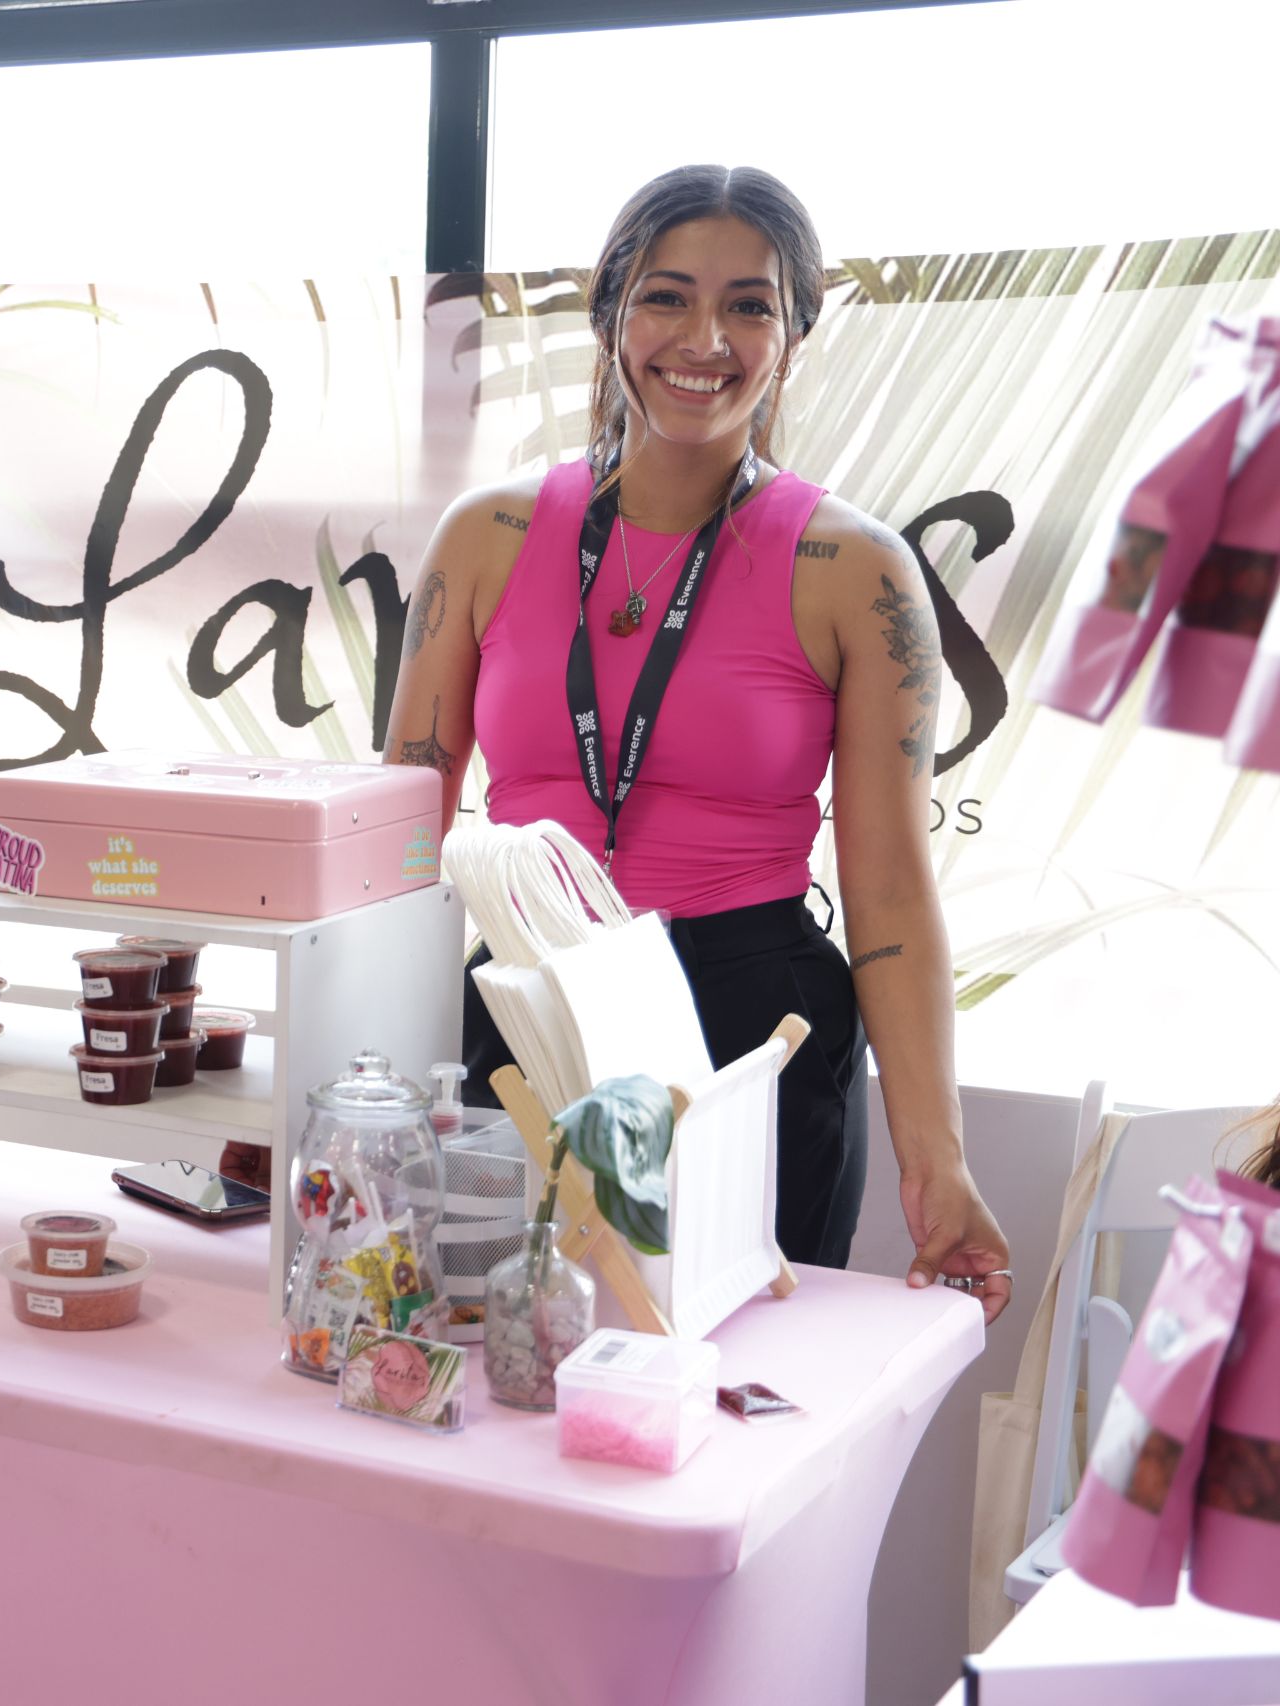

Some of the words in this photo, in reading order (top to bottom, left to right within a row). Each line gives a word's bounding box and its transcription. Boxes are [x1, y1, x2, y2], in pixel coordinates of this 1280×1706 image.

[677, 551, 706, 606] Everence
[624, 717, 646, 778] Everence
[584, 737, 600, 798] Everence
[107, 836, 133, 853] it's
[88, 858, 128, 874] what
[131, 858, 158, 874] she
[91, 880, 157, 896] deserves
[95, 1032, 119, 1043] Fresa
[85, 1074, 106, 1084] Fresa
